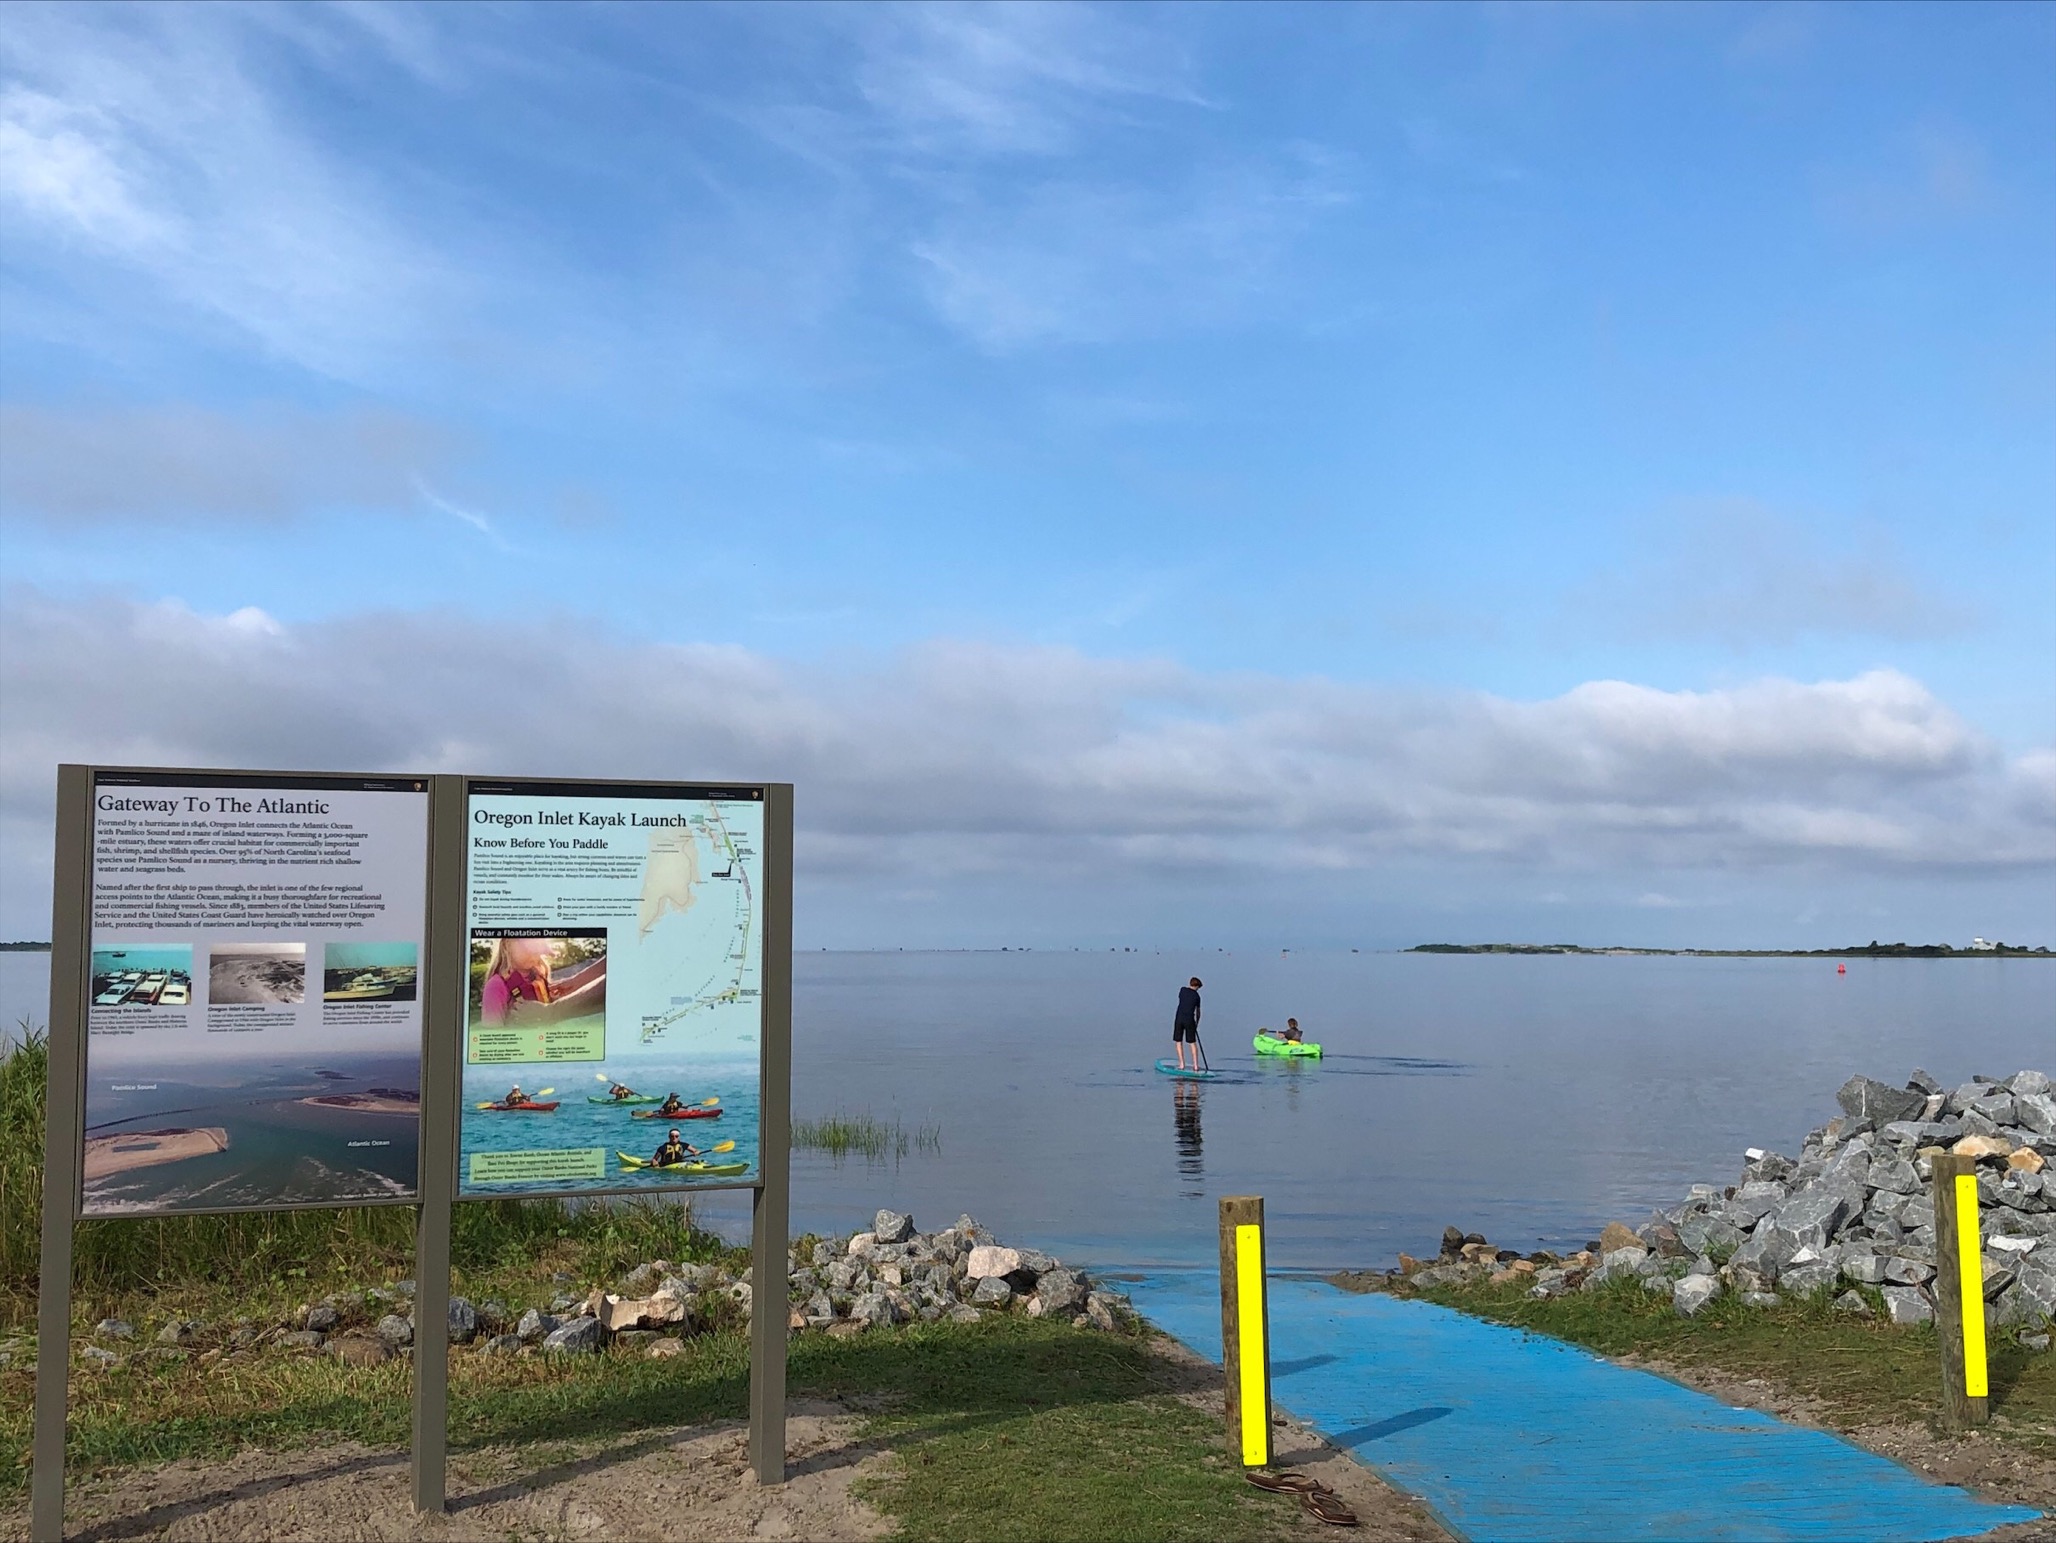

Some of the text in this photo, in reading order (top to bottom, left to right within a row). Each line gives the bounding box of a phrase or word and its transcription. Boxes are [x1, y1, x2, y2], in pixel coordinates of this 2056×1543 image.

[98, 795, 330, 816] Gateway To The Atlantic
[128, 820, 137, 828] by
[210, 821, 237, 829] Oregon
[474, 810, 533, 828] Oregon
[538, 812, 574, 825] Inlet
[578, 812, 626, 830] Kayak
[630, 813, 687, 828] Launch
[286, 830, 317, 839] Forming
[118, 839, 146, 847] estuary,
[276, 840, 323, 848] commercially
[324, 840, 359, 848] important
[474, 838, 609, 850] Know Before You Paddle
[96, 857, 123, 865] species
[239, 857, 268, 865] thriving
[335, 885, 363, 893] regional
[224, 894, 250, 902] making
[155, 903, 180, 911] fishing
[350, 903, 385, 911] Lifesaving
